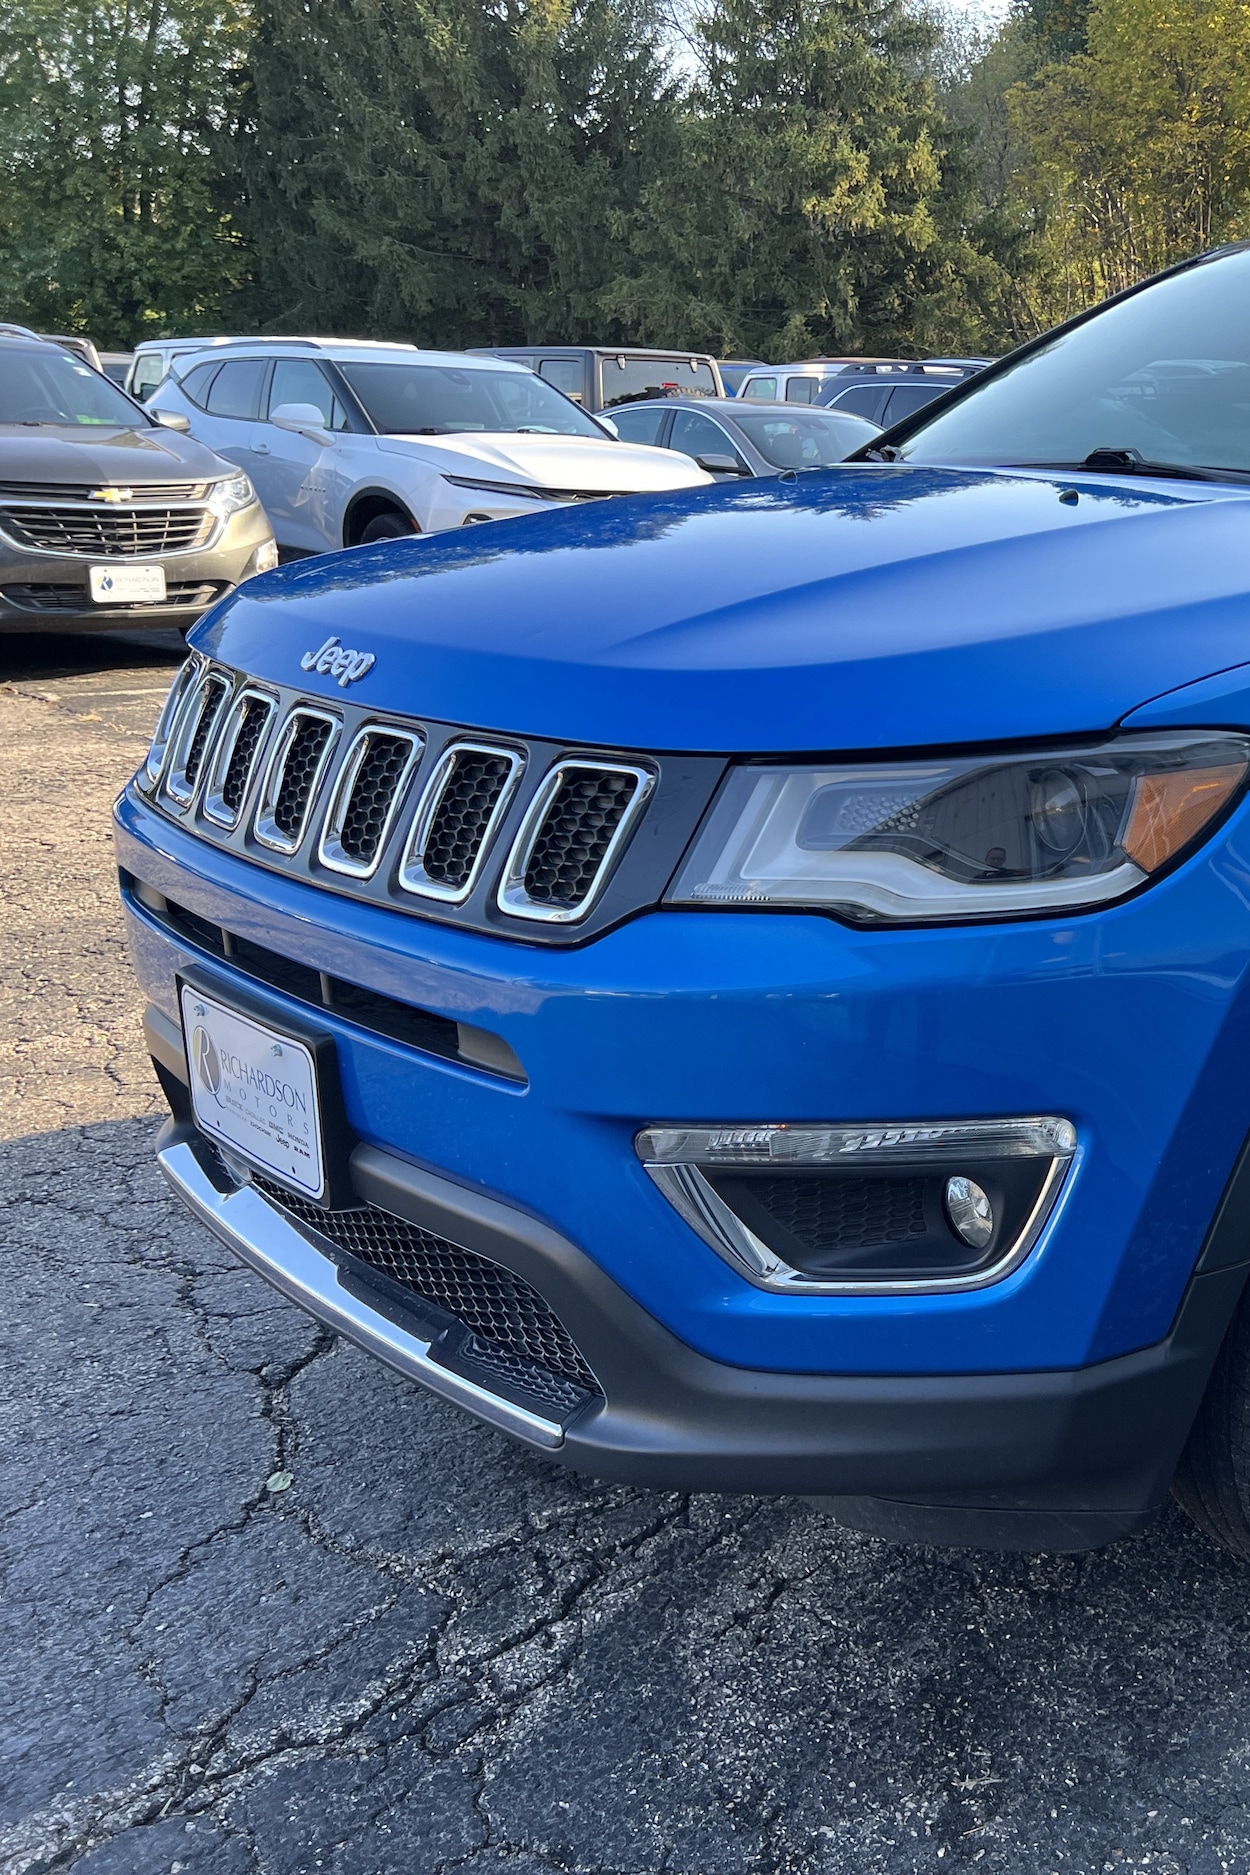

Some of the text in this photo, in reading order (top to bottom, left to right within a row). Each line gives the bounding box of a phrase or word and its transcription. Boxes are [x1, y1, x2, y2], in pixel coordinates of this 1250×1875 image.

[301, 636, 376, 688] Jeep
[220, 1048, 307, 1114] RICHARDSON
[276, 1134, 290, 1150] Jeep
[294, 1146, 310, 1160] RAM
[287, 1132, 309, 1149] HONDA
